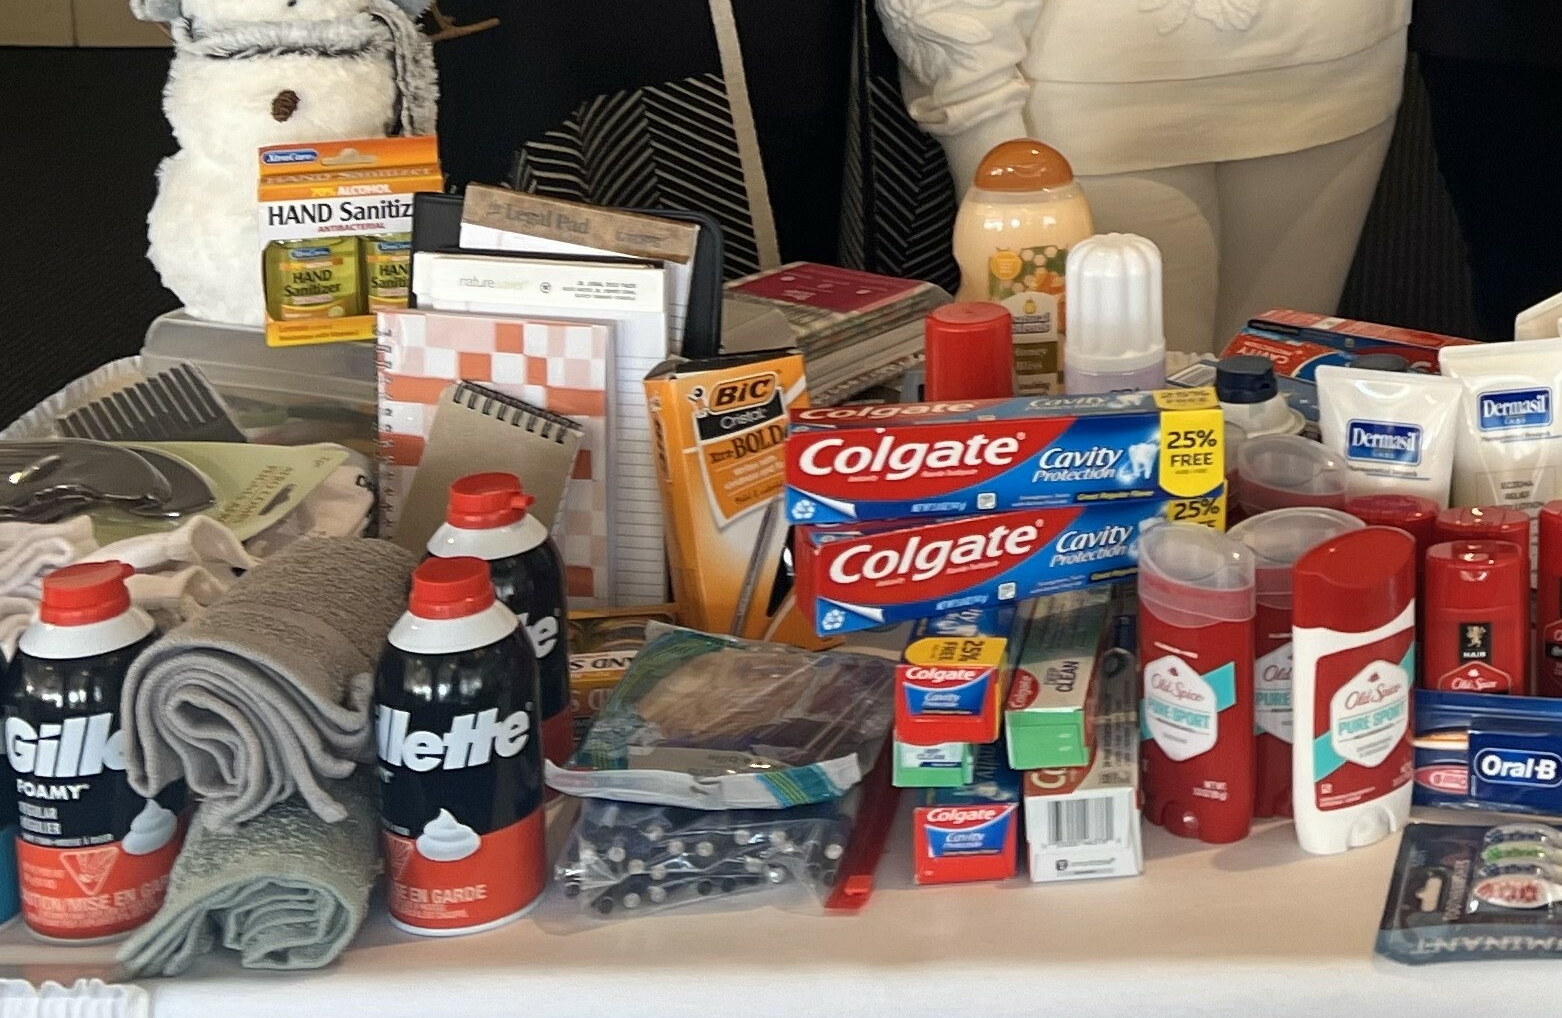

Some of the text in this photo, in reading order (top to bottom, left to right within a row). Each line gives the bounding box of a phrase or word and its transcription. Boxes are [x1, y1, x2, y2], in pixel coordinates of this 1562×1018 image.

[337, 184, 392, 196] ALCOHOL
[268, 203, 333, 226] HAND
[317, 223, 385, 233] ANTIBACTERIAL
[292, 269, 333, 283] HAND
[799, 402, 975, 420] Colgate
[1483, 394, 1547, 419] Dermasil
[731, 425, 784, 460] BOLD
[1167, 429, 1218, 450] 25%
[1351, 427, 1418, 452] Dermasil
[799, 433, 1020, 481] Colgate
[1039, 445, 1124, 471] Cavity
[1170, 453, 1214, 468] FREE
[1032, 468, 1117, 483] Protection
[1173, 498, 1221, 520] 25%
[1056, 525, 1133, 554] Cavity
[829, 524, 1038, 585] Colgate
[1050, 545, 1129, 568] Protection
[938, 641, 958, 661] FREE
[958, 638, 985, 663] 25%
[905, 666, 977, 684] Colgate
[1055, 660, 1080, 693] CLEAN
[1451, 677, 1474, 691] Old
[924, 691, 962, 705] Cavity
[1010, 674, 1034, 708] Colgate
[1151, 672, 1205, 703] Old Spice
[1256, 691, 1293, 707] PURE
[1345, 690, 1370, 711] Old
[1174, 706, 1211, 729] SPORT
[1337, 699, 1406, 735] PURE SPORT
[1481, 754, 1558, 780] Oral-B
[16, 778, 83, 801] FOAMY
[926, 807, 996, 824] Colgate
[945, 831, 985, 844] Cavity
[410, 884, 488, 903] EN GARDE
